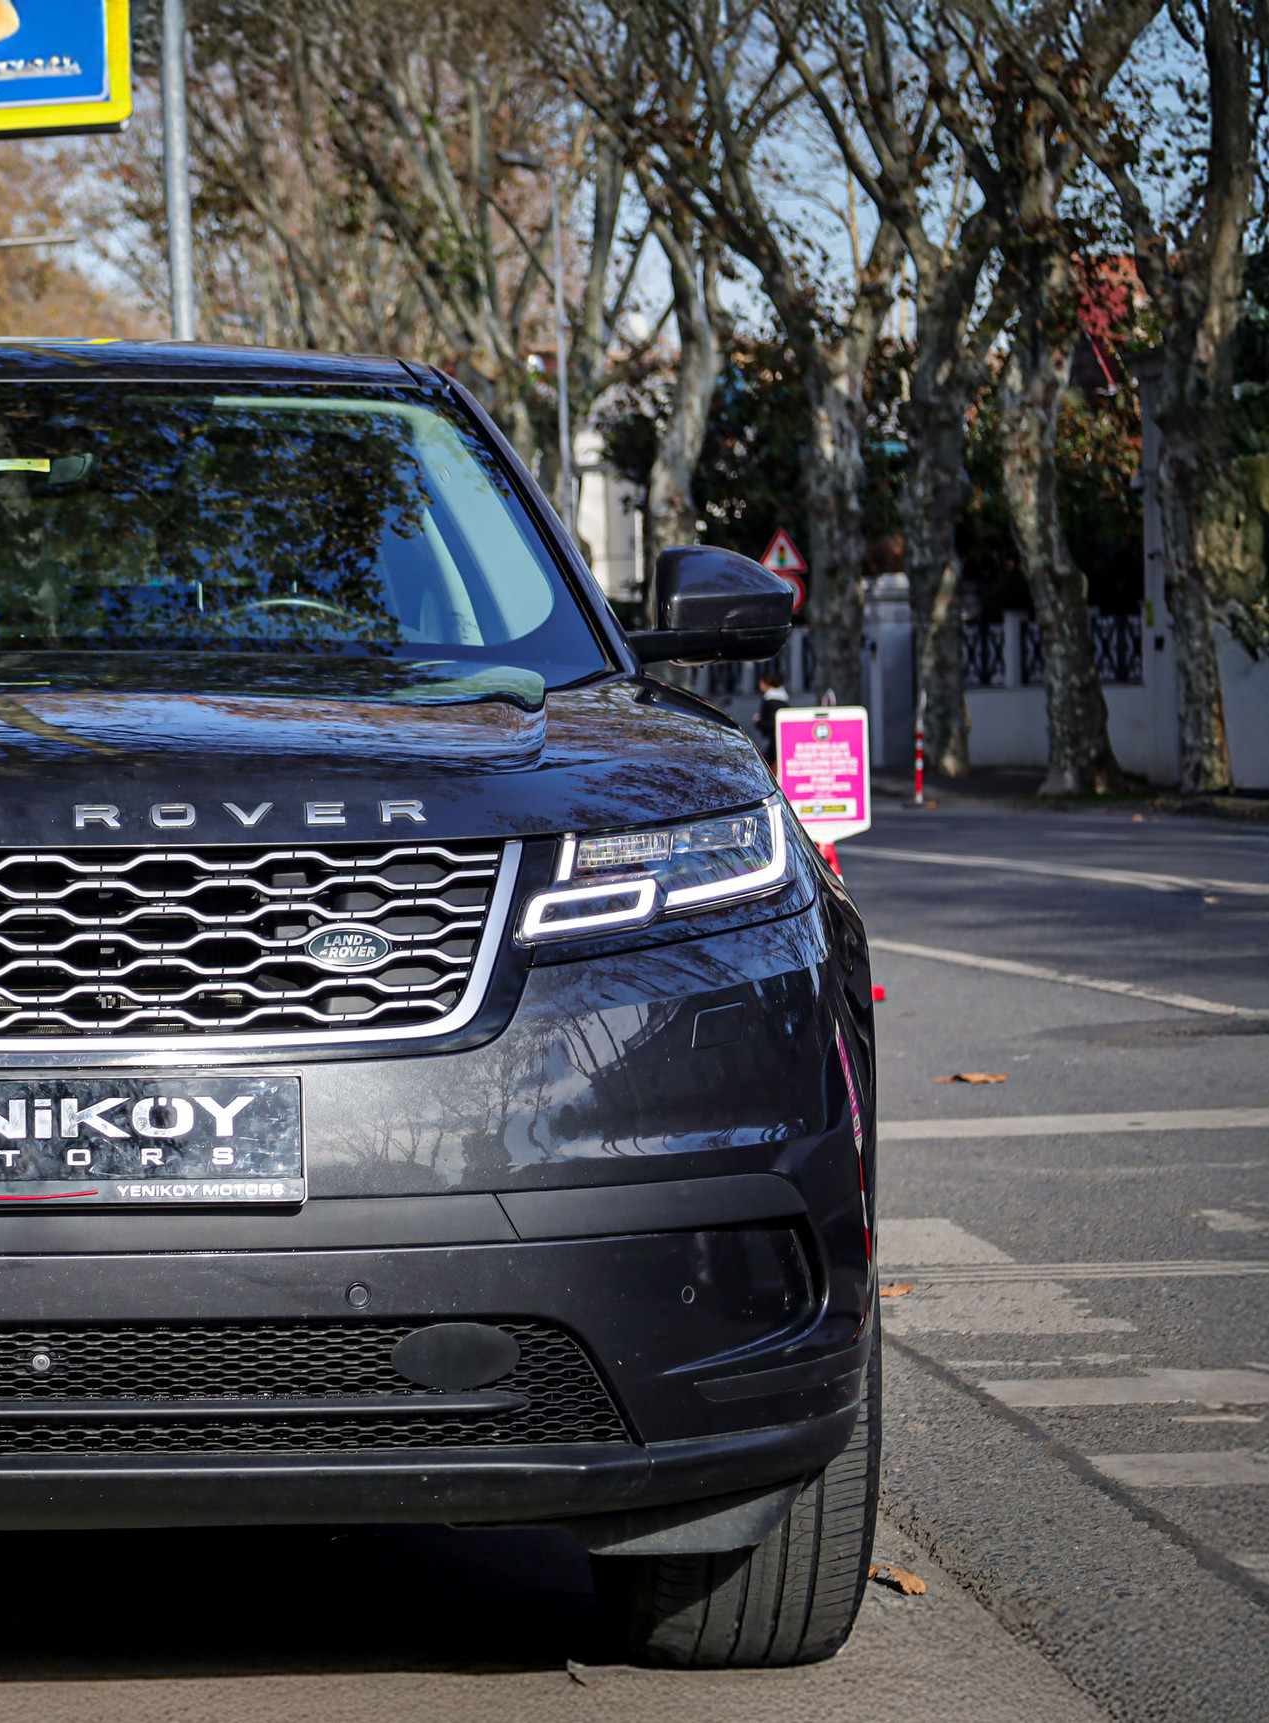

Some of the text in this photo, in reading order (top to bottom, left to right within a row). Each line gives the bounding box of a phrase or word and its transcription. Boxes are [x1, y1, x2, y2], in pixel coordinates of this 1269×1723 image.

[73, 799, 427, 828] ROVER
[323, 935, 363, 947] LAND
[328, 946, 377, 958] ROVER
[202, 1183, 285, 1197] MOTORS
